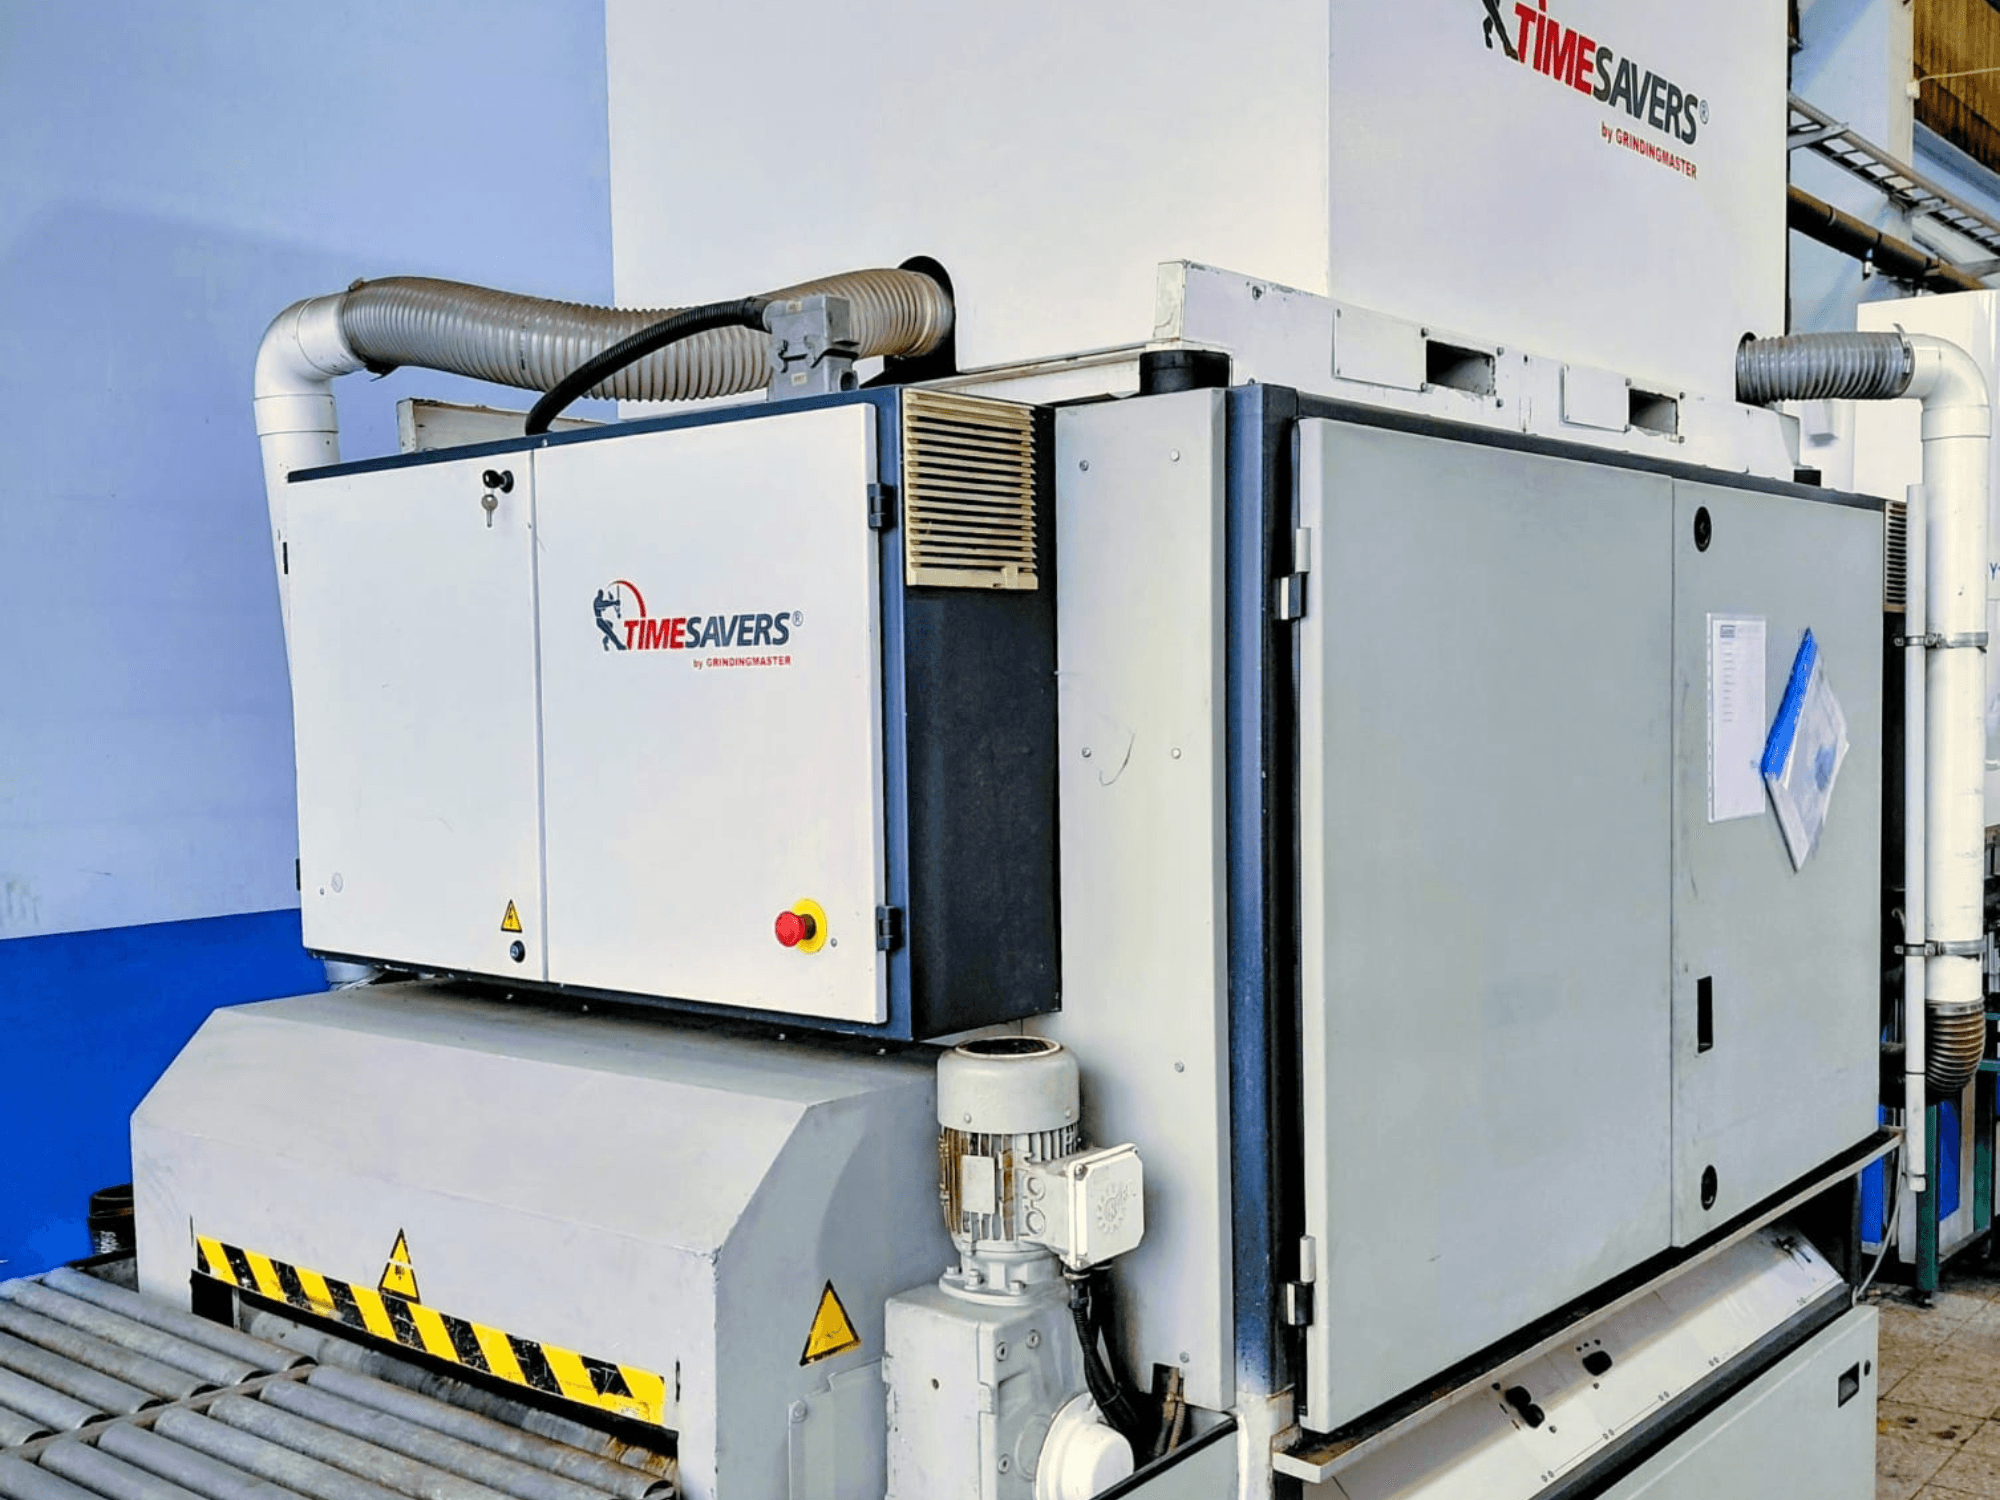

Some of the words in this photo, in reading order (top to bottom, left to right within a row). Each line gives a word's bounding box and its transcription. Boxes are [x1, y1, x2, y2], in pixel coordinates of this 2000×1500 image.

[1601, 121, 1613, 144] by
[1615, 128, 1697, 180] GRINDINGMASTER
[693, 659, 703, 670] by
[706, 655, 791, 667] GRINDINGMASTER
